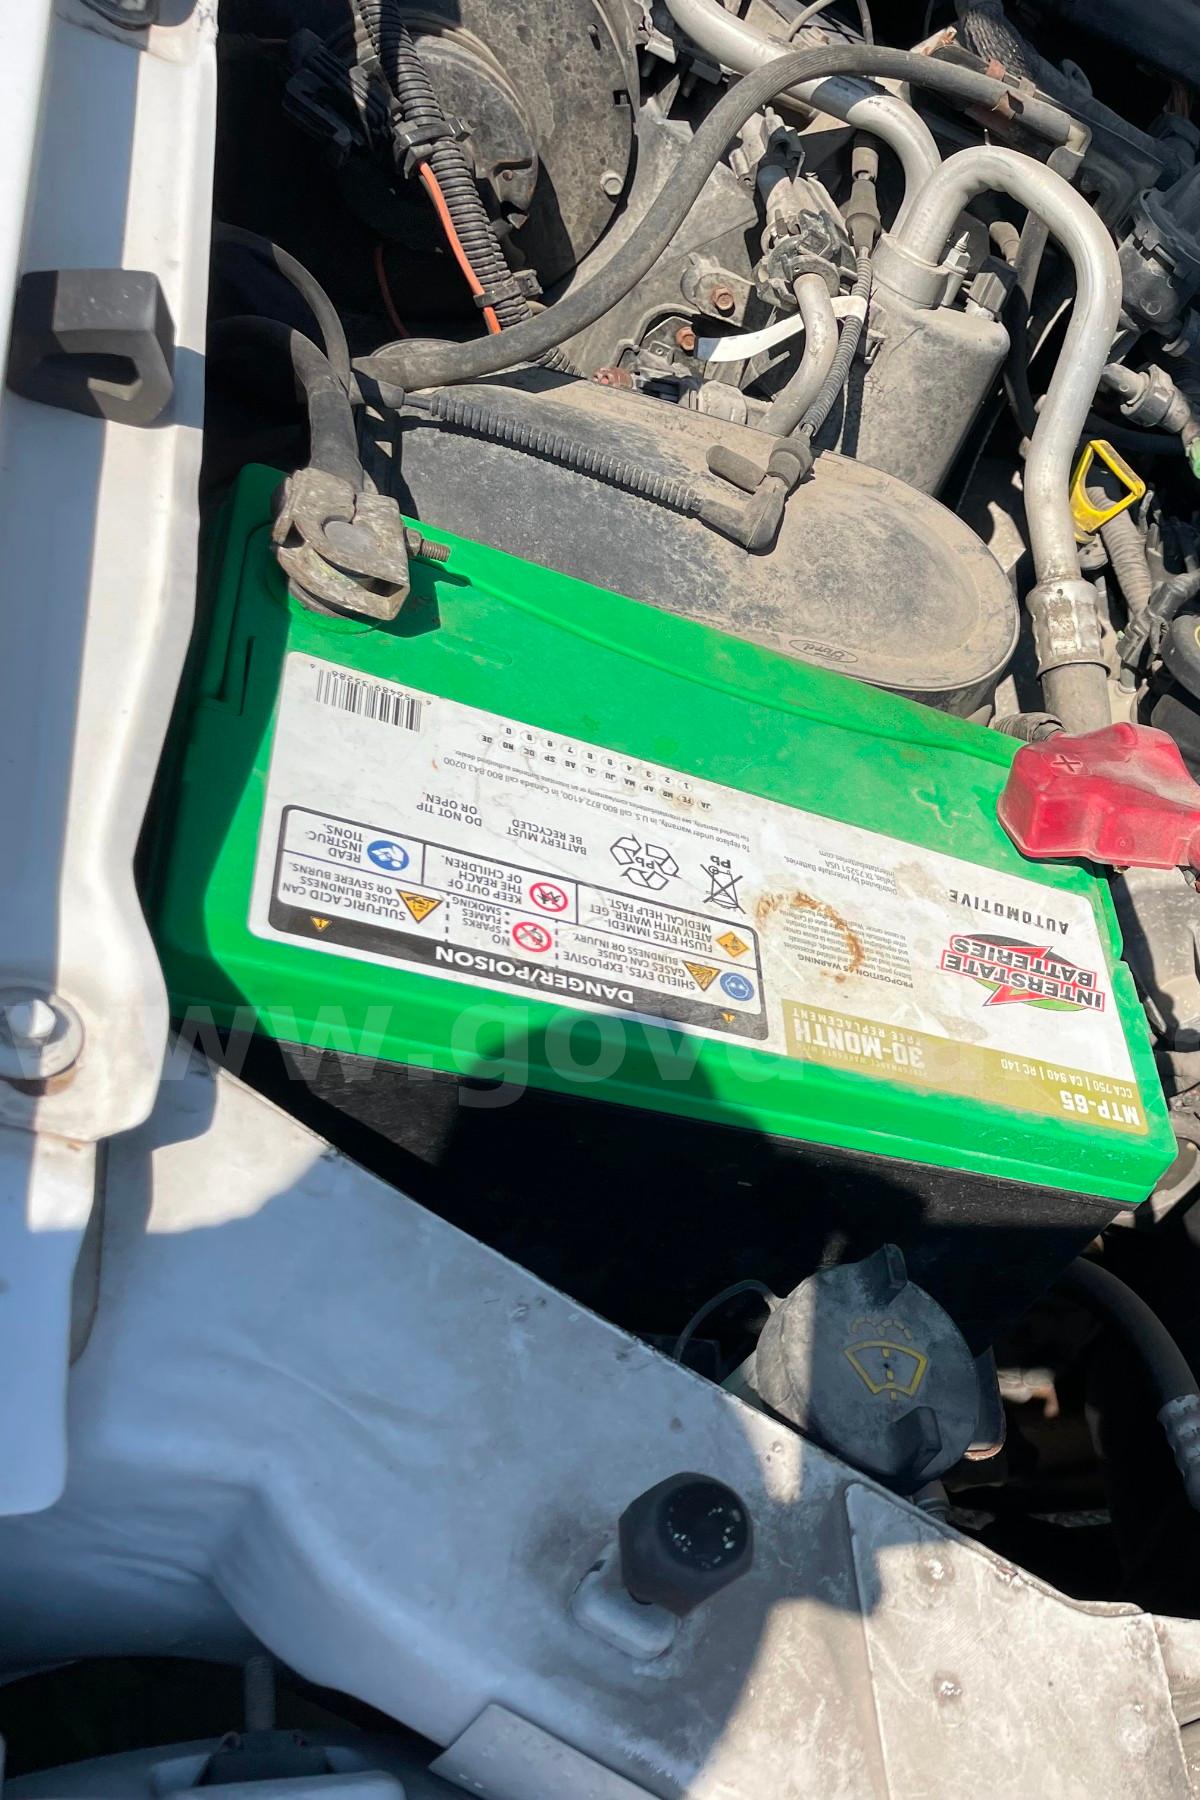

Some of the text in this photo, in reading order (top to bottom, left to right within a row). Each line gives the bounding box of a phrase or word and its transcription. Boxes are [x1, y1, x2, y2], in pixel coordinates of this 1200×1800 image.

[330, 669, 410, 700] 56489 35286
[415, 800, 481, 826] DO NOT TIP
[421, 791, 477, 815] OR OPEN.
[442, 756, 750, 852] To replace under warranty, in U.S. call 800.872.4100, in Canada call 800.843.0200
[303, 828, 362, 853] INSTRUC-
[322, 822, 364, 842] TIONS.
[505, 825, 586, 855] BATTERY MUST
[511, 817, 582, 845] BE RECYCLED
[327, 846, 361, 863] READ
[440, 854, 522, 884] OF CHILDREN.
[634, 854, 655, 870] Pb
[709, 853, 731, 870] Pb
[287, 860, 392, 895] OR SEVERE BURNS.
[446, 876, 522, 904] KEEP OUT OF
[458, 869, 522, 894] THE REACH
[782, 854, 898, 896] Distributed by Interstate Batteries,
[281, 881, 406, 921] SULFURIC ACID CAN
[298, 874, 399, 908] CAUSE BLINDNESS
[450, 895, 502, 915] SMOKING
[461, 907, 501, 924] FLAMES
[461, 916, 501, 933] SPARKS
[589, 902, 712, 943] ATELY WITH WATER. GET
[607, 897, 711, 933] MEDICAL HELP FAST.
[945, 886, 1072, 937] AUTOMOTIVE
[491, 932, 510, 946] NO
[572, 931, 678, 966] BLINDNESS OR INJURY.
[603, 916, 712, 953] FLUSH EYES IMMEDI-
[433, 943, 634, 1005] DANGER/POISON
[563, 950, 695, 990] SHIELD EYES. EXPLOSIVE
[596, 947, 685, 978] GASES CAN CAUSE
[796, 952, 842, 971] WARNING
[950, 934, 1095, 989] BATTERIES
[854, 967, 914, 989] PROPOSITION
[942, 950, 1105, 1010] INTERSTATE
[790, 1005, 921, 1046] FREE REPLACEMENT
[792, 1016, 926, 1070] 30-MONTH
[999, 1056, 1134, 1100] CCA 750 CA 940 RC 140
[1058, 1088, 1141, 1127] MTP-65
